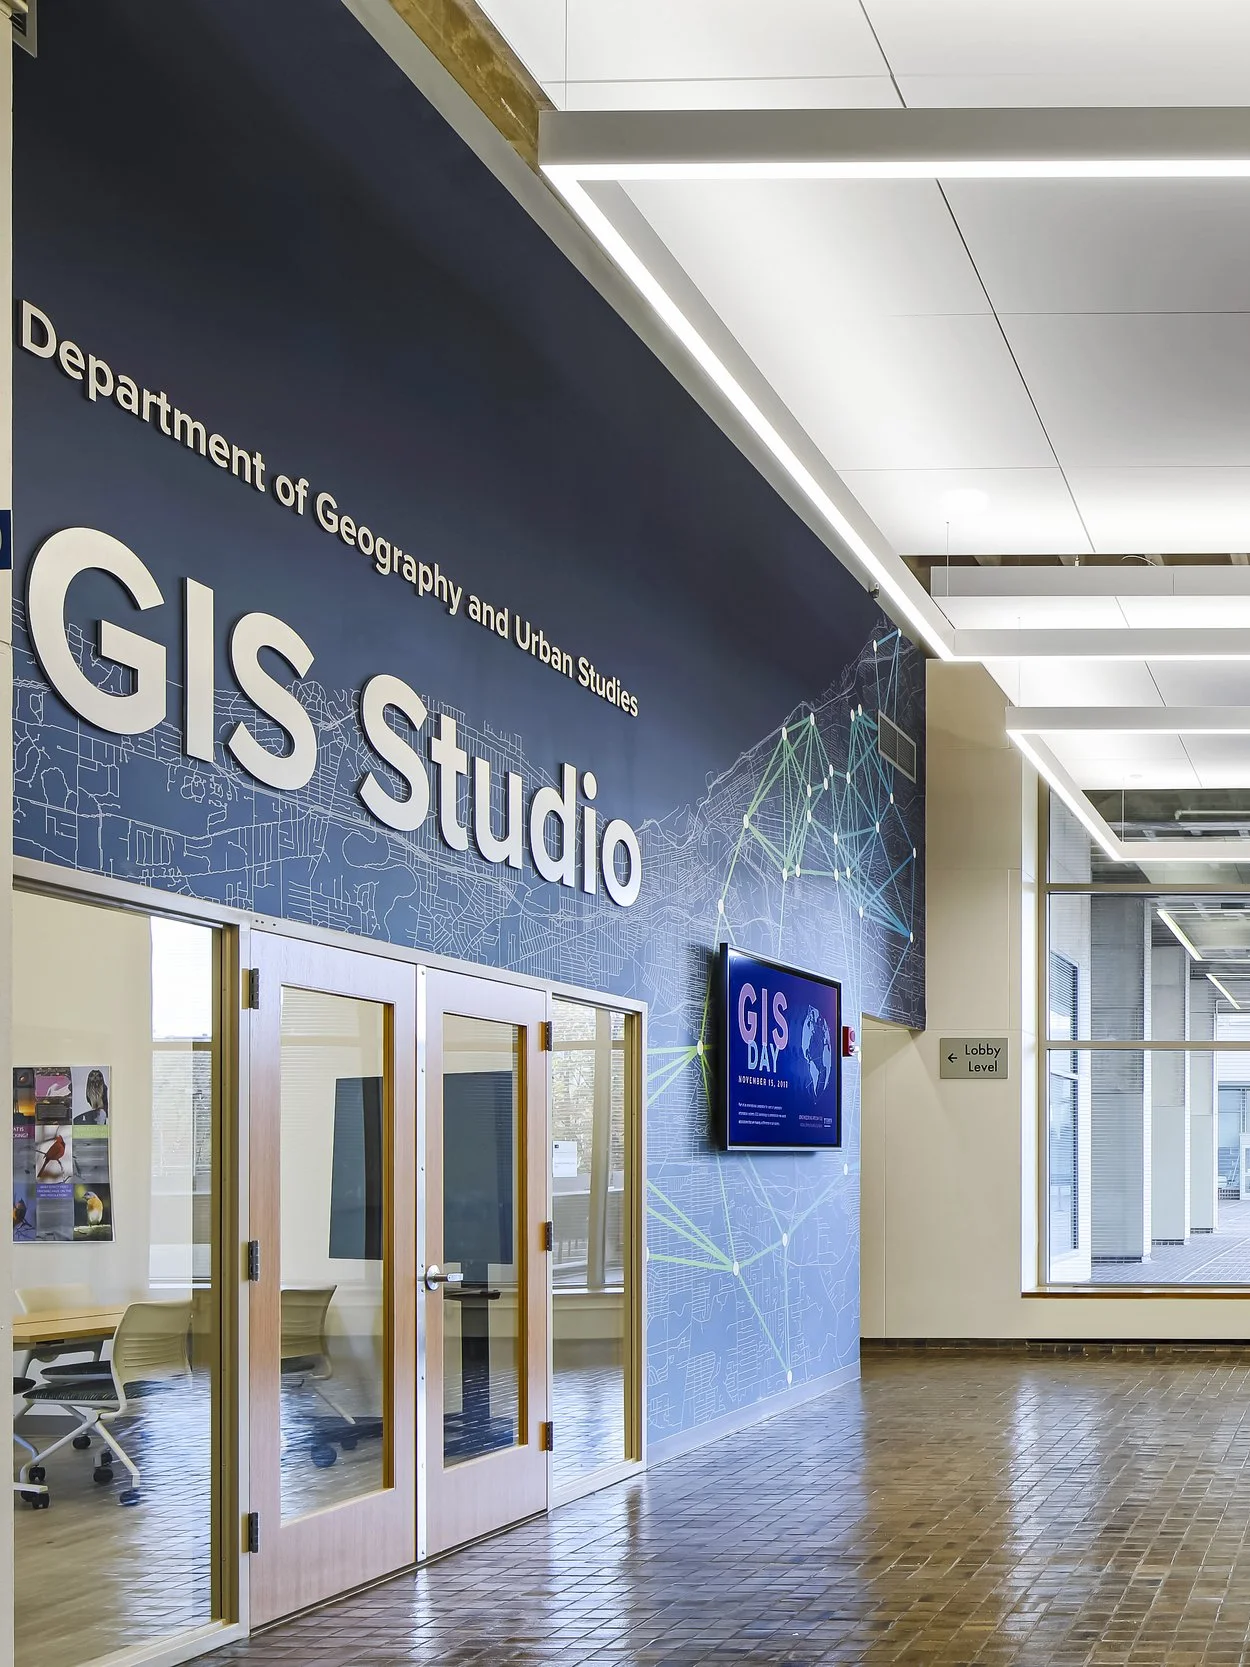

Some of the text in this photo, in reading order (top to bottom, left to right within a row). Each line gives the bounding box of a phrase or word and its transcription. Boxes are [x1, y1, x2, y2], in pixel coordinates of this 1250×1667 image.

[20, 299, 639, 718] Department of Geography and Urban Studies
[26, 526, 643, 908] GIS Studio
[738, 982, 789, 1051] GIS
[747, 1040, 780, 1074] DAY
[965, 1043, 1001, 1059] Lobby
[968, 1059, 998, 1073] Level
[738, 1075, 767, 1087] NOVEMBER
[768, 1078, 776, 1089] 15,
